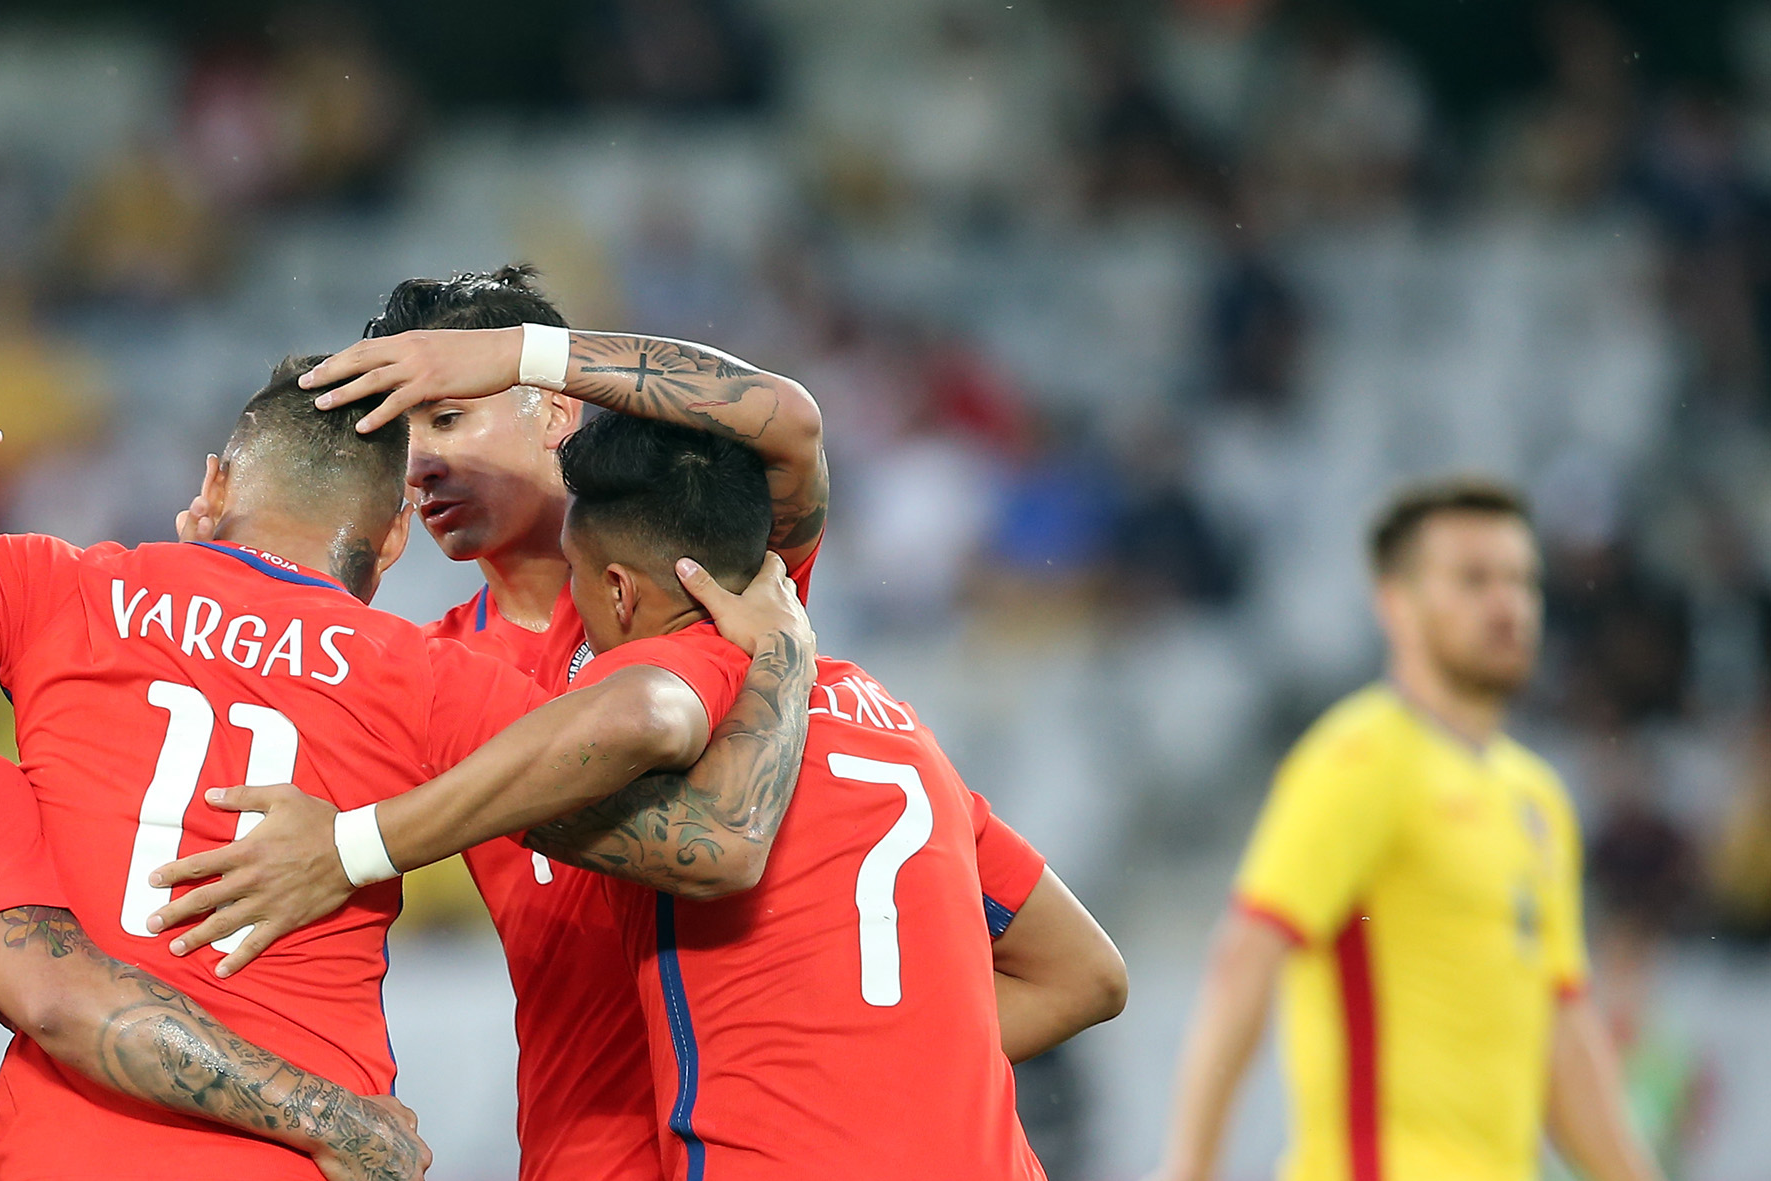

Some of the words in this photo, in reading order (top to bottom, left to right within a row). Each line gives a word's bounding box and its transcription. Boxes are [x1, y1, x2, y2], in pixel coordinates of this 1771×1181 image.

[260, 551, 299, 573] ROJA
[111, 579, 356, 686] VARGAS
[568, 641, 592, 684] ERACIO
[120, 680, 299, 954] 11
[827, 752, 934, 1007] 7
